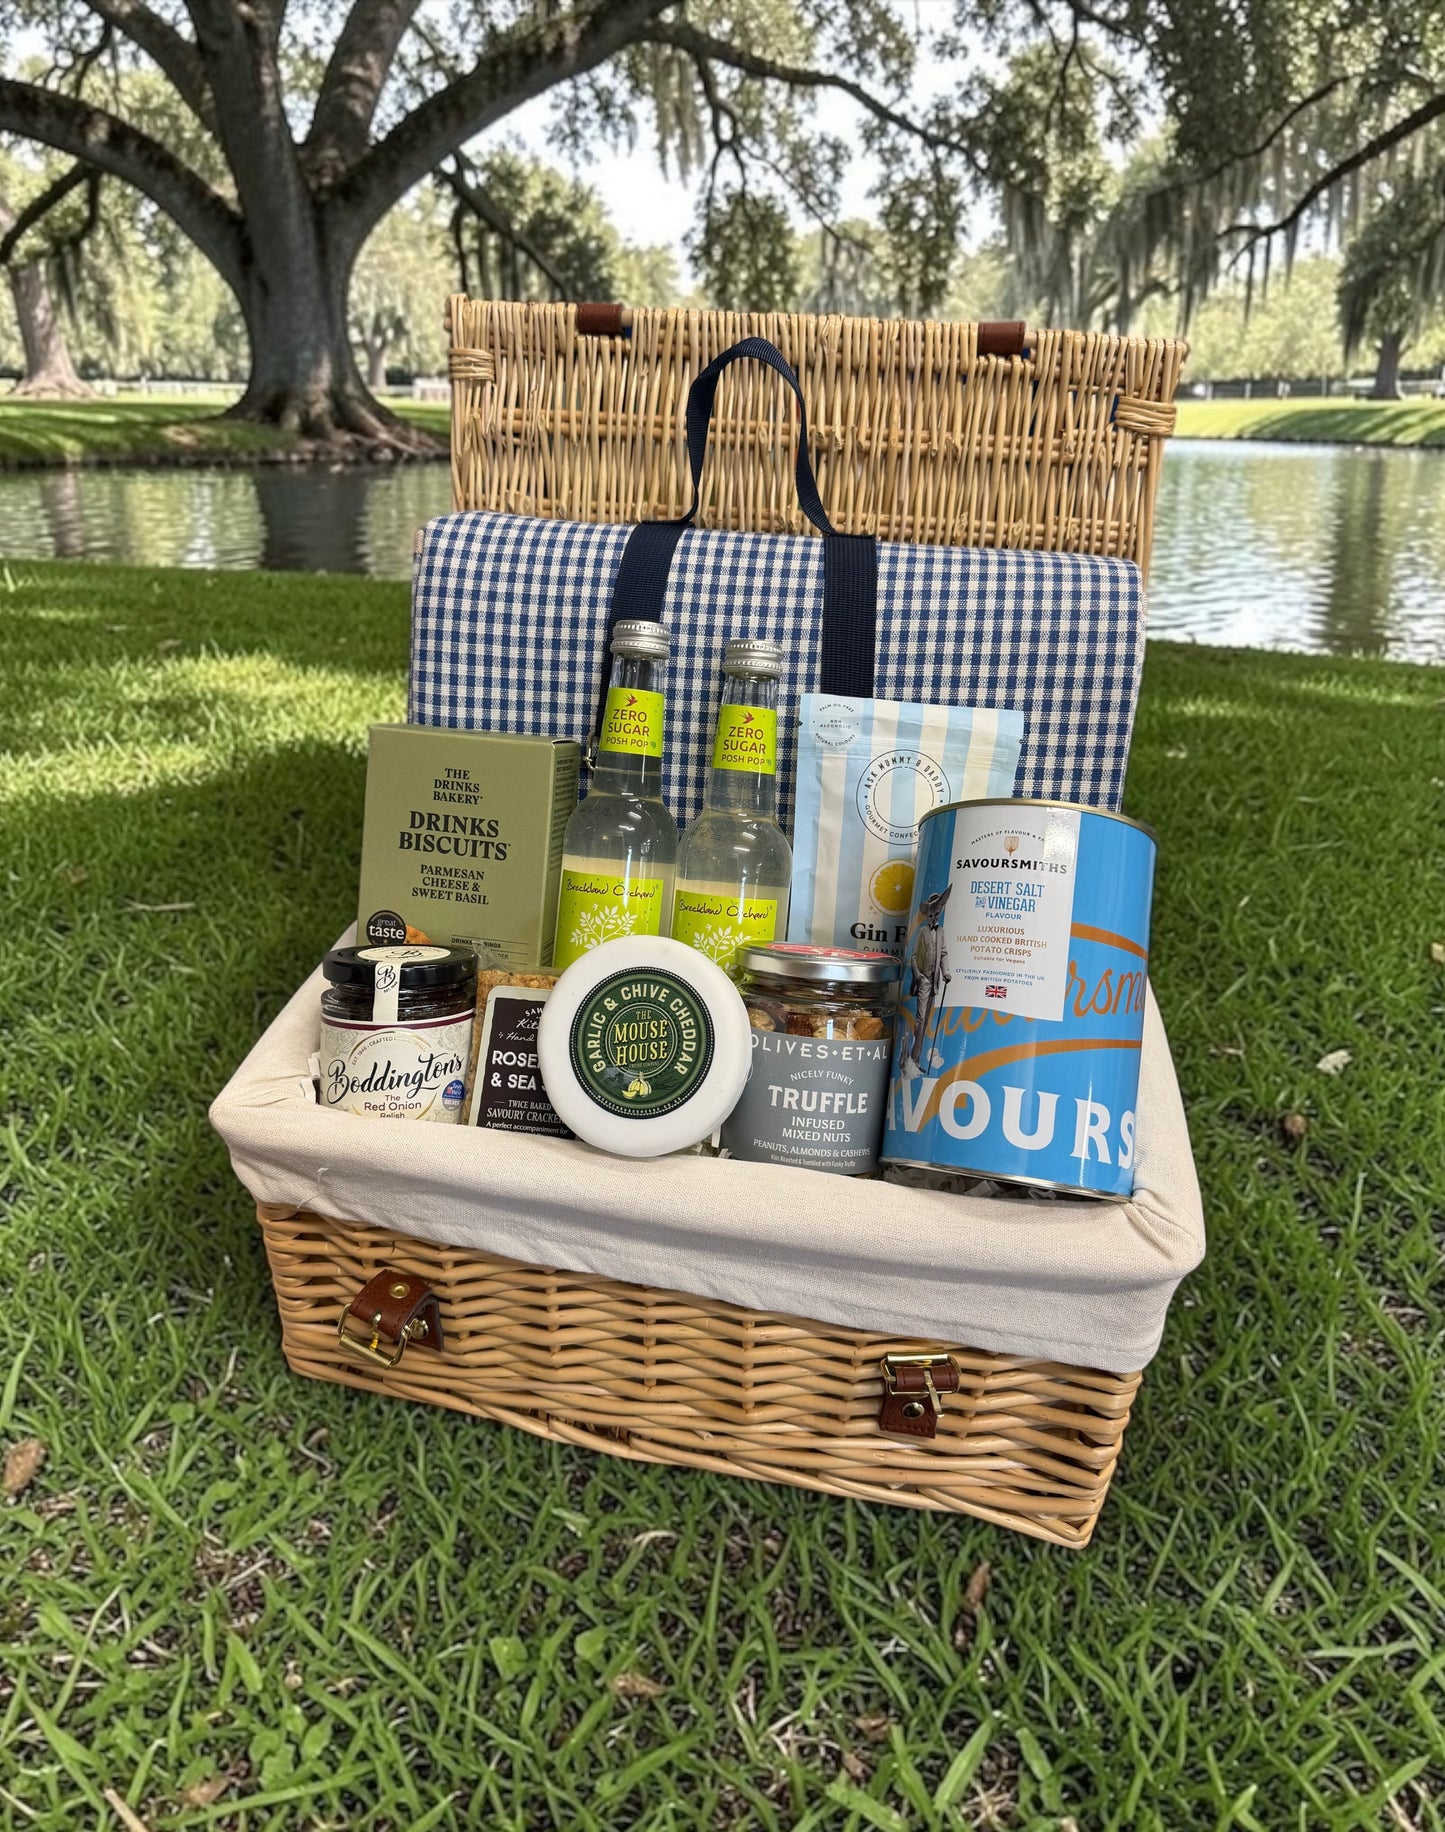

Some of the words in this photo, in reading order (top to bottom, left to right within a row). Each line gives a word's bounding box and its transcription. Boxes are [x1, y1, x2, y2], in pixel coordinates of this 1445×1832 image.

[612, 708, 647, 723] ZERO
[607, 722, 650, 737] SUGAR
[728, 726, 764, 740] ZERO
[606, 736, 628, 745] POSH
[630, 739, 649, 748] POP
[722, 739, 766, 755] SUGAR
[721, 754, 745, 763] POSH
[747, 756, 765, 766] POP
[445, 768, 470, 780] THE
[864, 771, 878, 789] ASK
[878, 756, 912, 771] MUMMY
[923, 765, 945, 793] DADDY
[434, 779, 480, 793] DRINKS
[433, 791, 480, 805] BAKERY
[409, 811, 499, 838] DRINKS
[865, 804, 889, 835] GOURMET
[889, 830, 919, 839] CONFEC
[399, 831, 507, 861] BISCUITS
[420, 864, 485, 880] PARMESAN
[956, 858, 1067, 874] SAVOURSMITHS
[422, 877, 470, 891] CHEESE
[472, 882, 480, 892] &
[565, 878, 609, 895] Breckland
[612, 883, 656, 899] Ochard
[970, 881, 1012, 895] DESERT
[1015, 882, 1046, 898] SALT
[412, 887, 453, 900] SWEET
[455, 892, 489, 905] BASIL
[679, 898, 723, 915] Breckland
[726, 905, 770, 920] Ochard
[988, 896, 1036, 913] VINEGAR
[377, 918, 397, 927] great
[985, 911, 1022, 921] FLAVOUR
[368, 925, 405, 940] taste
[850, 922, 888, 942] Gin
[893, 925, 908, 942] F
[977, 925, 1025, 936] LUXURIOUS
[956, 935, 979, 943] HAND
[980, 936, 1012, 945] COOKED
[1014, 938, 1047, 949] BRITISH
[970, 945, 1002, 954] POTATO
[1004, 947, 1032, 957] CRISPS
[1003, 978, 1033, 986] POTATOES
[525, 1007, 544, 1017] SAW
[635, 1010, 652, 1021] THE
[516, 1017, 539, 1030] Kit
[587, 1011, 607, 1073] GARLIC
[603, 997, 619, 1011] &
[620, 983, 670, 1003] CHIVE
[669, 998, 697, 1076] CHEDDAR
[506, 1031, 536, 1042] Hand
[613, 1019, 668, 1044] MOUSE
[369, 1036, 393, 1047] CRAFTED
[491, 1050, 540, 1069] ROSE
[615, 1040, 668, 1067] HOUSE
[326, 1052, 465, 1104] Boddington's
[490, 1072, 502, 1088] &
[507, 1073, 537, 1091] SEA
[790, 1070, 824, 1082] NICELY
[826, 1070, 854, 1086] FUNKY
[385, 1094, 401, 1102] The
[508, 1099, 528, 1108] TWICE
[529, 1102, 552, 1111] BAKED
[767, 1084, 869, 1114] TRUFFLE
[364, 1101, 386, 1111] Red
[389, 1101, 422, 1111] Onion
[486, 1107, 526, 1121] SAVOURY
[526, 1111, 562, 1124] CRACKE
[791, 1116, 845, 1130] INFUSED
[492, 1121, 512, 1130] perfect
[513, 1124, 559, 1134] accompaniment
[782, 1127, 821, 1141] MIXED
[823, 1132, 851, 1143] NUTS
[753, 1138, 789, 1154] PEANUTS,
[790, 1146, 832, 1158] ALMONDS
[832, 1150, 840, 1158] &
[840, 1147, 871, 1158] CASHEWS
